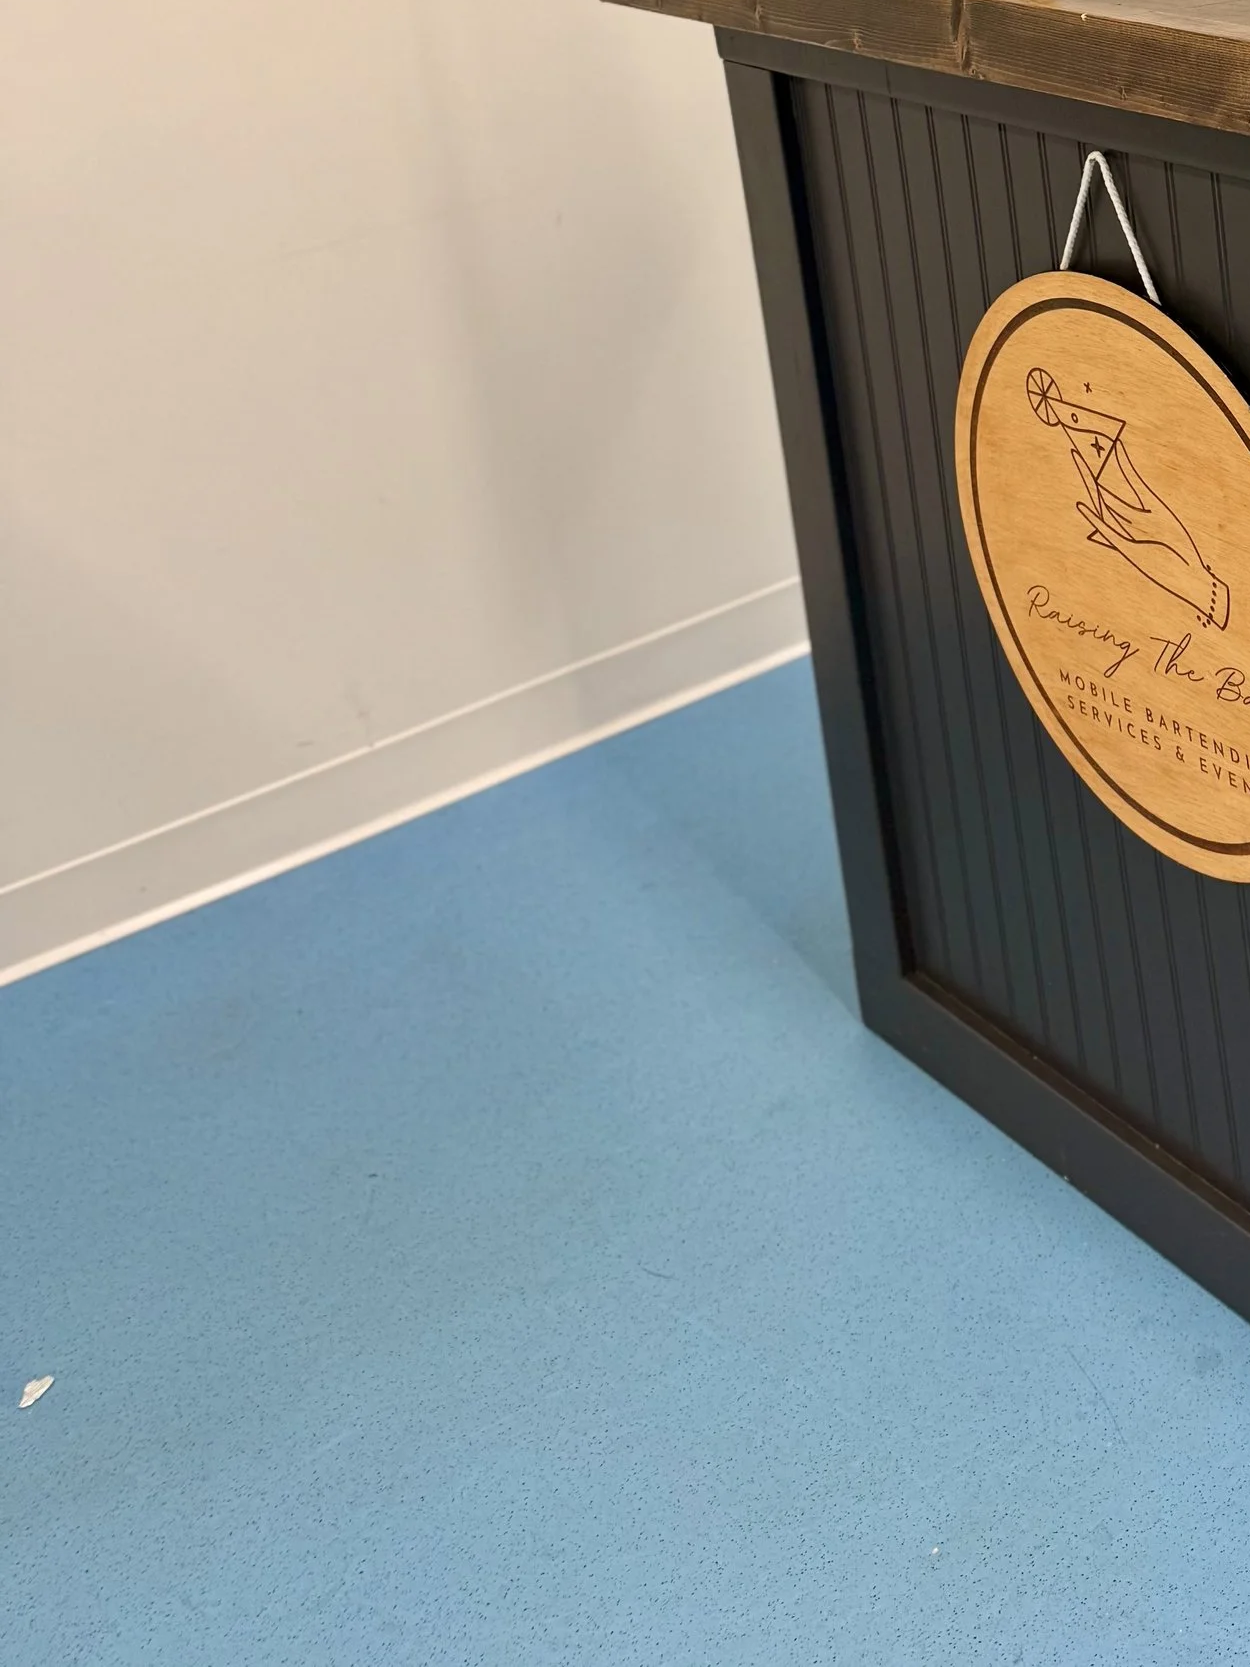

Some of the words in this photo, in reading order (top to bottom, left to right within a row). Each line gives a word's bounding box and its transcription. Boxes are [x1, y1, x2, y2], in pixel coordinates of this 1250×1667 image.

[1026, 584, 1140, 679] Raising
[1149, 632, 1205, 682] The
[1058, 668, 1133, 714] MOBILE
[1066, 695, 1163, 752] SERVICES
[1175, 745, 1186, 763] &
